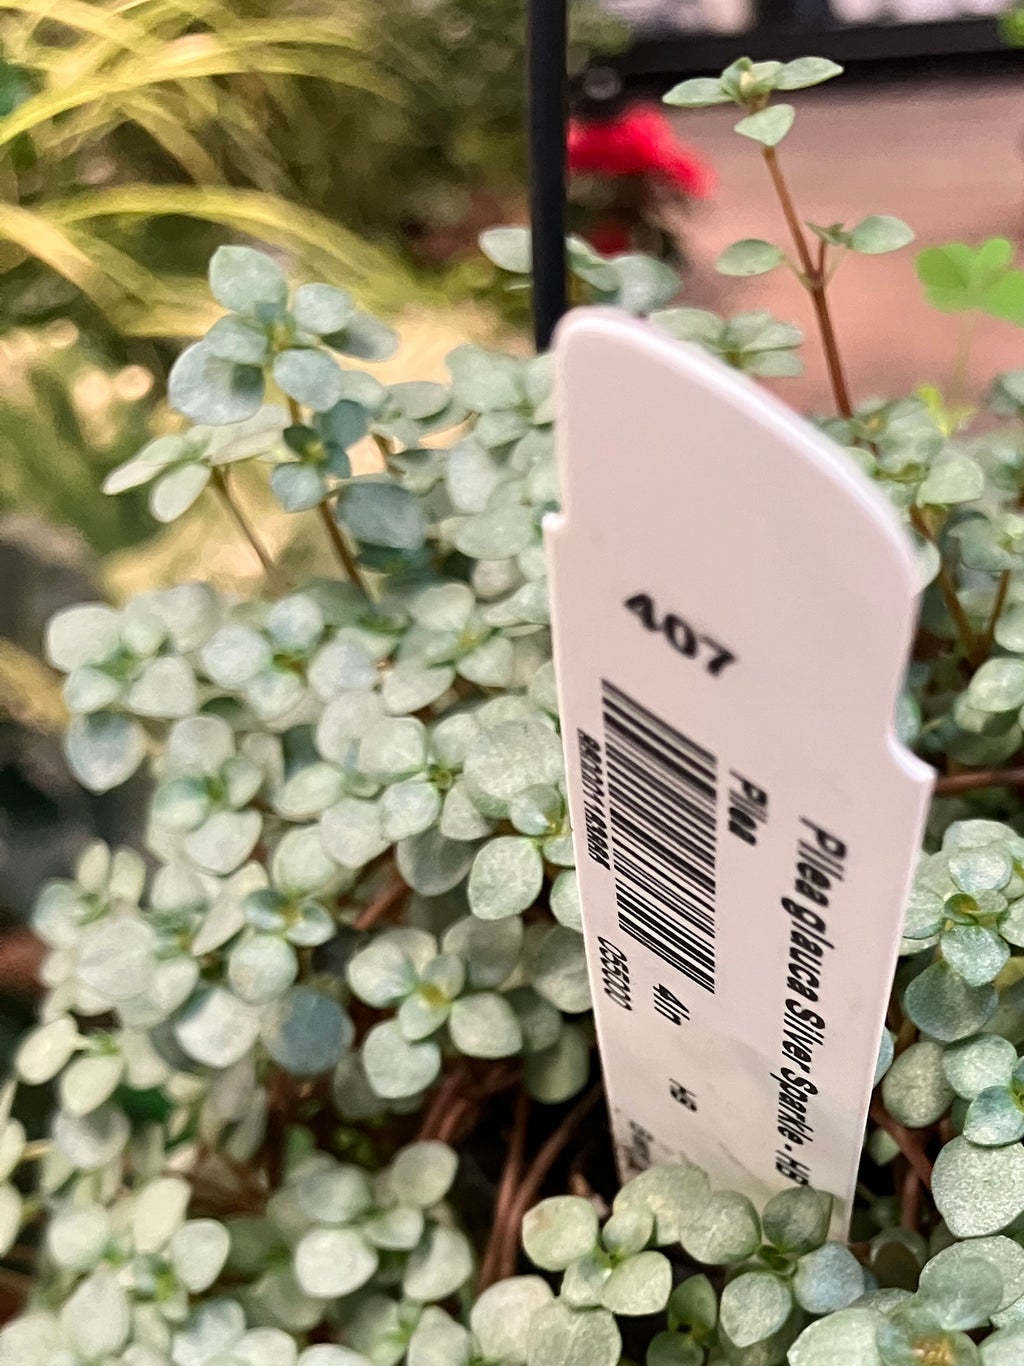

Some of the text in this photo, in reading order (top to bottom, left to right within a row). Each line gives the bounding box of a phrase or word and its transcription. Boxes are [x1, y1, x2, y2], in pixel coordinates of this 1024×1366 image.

[623, 592, 738, 677] 407
[727, 768, 768, 847] Pilea
[795, 815, 847, 908] Pilea
[597, 936, 633, 1011] 055000
[780, 896, 835, 1002] glauca
[652, 983, 690, 1026] 4in
[781, 998, 825, 1073] Silver
[668, 1077, 698, 1112] HB
[769, 1067, 818, 1145] Sparkle
[775, 1149, 811, 1185] HB
